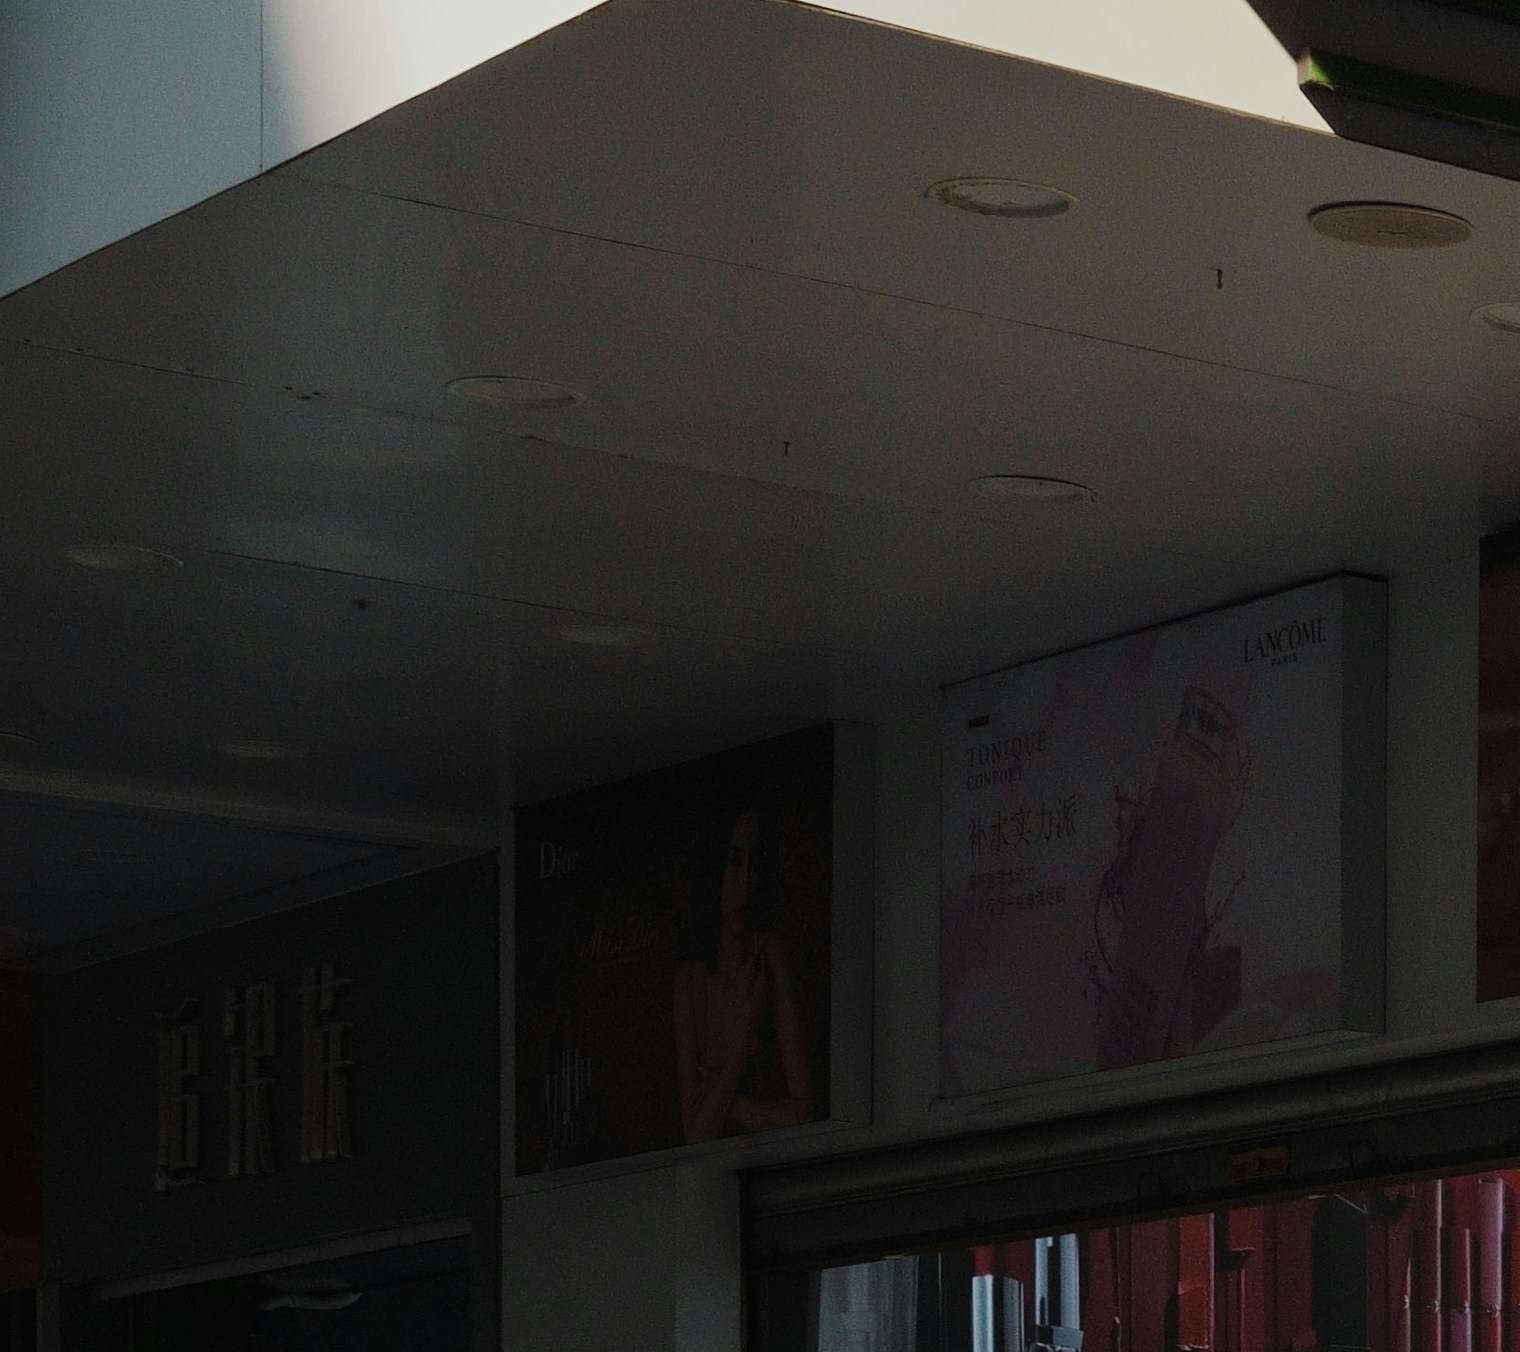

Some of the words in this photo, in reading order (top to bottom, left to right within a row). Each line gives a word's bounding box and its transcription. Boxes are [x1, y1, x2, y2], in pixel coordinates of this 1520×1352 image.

[1243, 617, 1329, 664] LANCÔME
[1270, 652, 1298, 668] PARIS
[967, 730, 1048, 768] TONIQUE
[966, 764, 1024, 791] CONFORT
[967, 795, 1078, 857] 补水实力派
[538, 840, 579, 879] Dior
